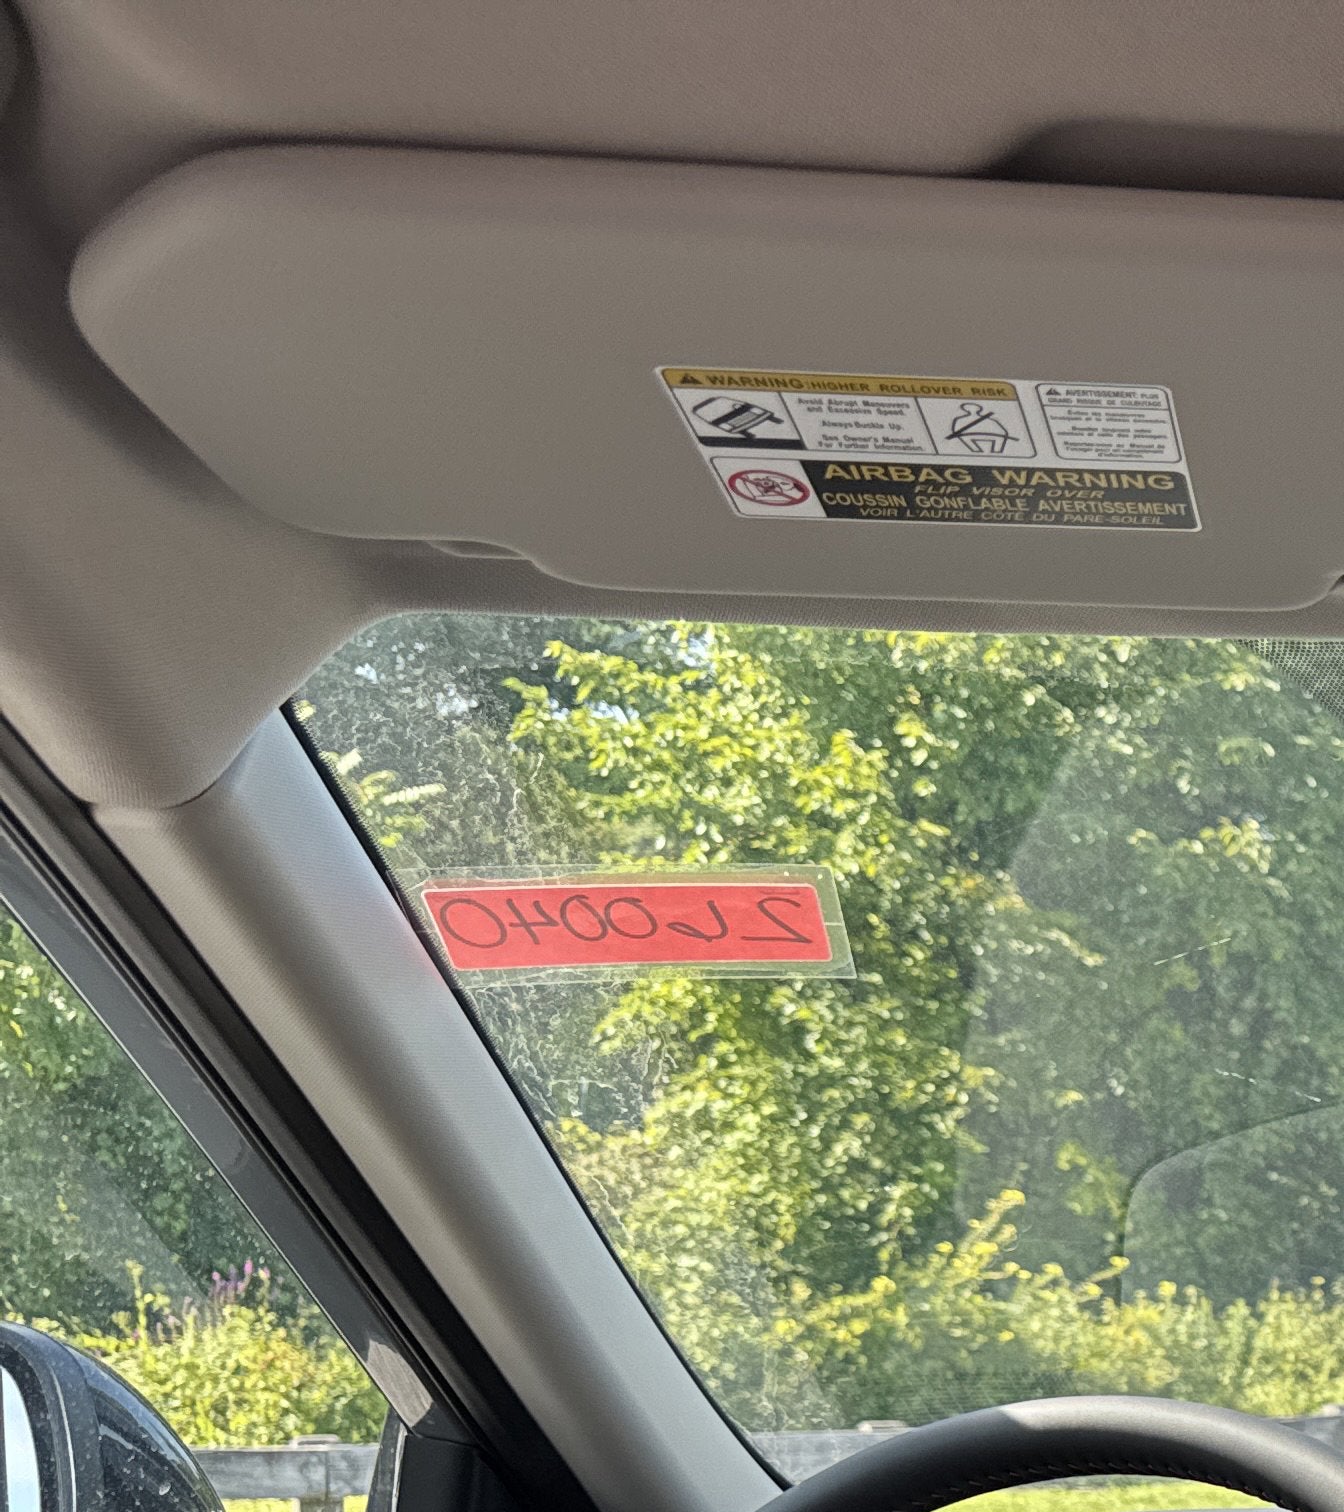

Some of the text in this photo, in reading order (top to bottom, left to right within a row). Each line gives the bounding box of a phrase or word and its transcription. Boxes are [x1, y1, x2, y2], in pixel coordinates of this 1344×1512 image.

[811, 381, 870, 392] HIGHER
[879, 384, 963, 396] ROLLOVER
[970, 387, 1008, 397] RISK
[824, 463, 1175, 490] AIRBAG WARNING
[914, 484, 1105, 499] FLIP VISOR OVER
[822, 492, 1188, 516] COUSSIN GONFLABLE AVERTISSEMENT
[859, 508, 898, 517] VOIR
[906, 509, 973, 520] L'AUTRE
[1032, 513, 1055, 522] DU
[1063, 514, 1165, 525] PARE-SOLEIL
